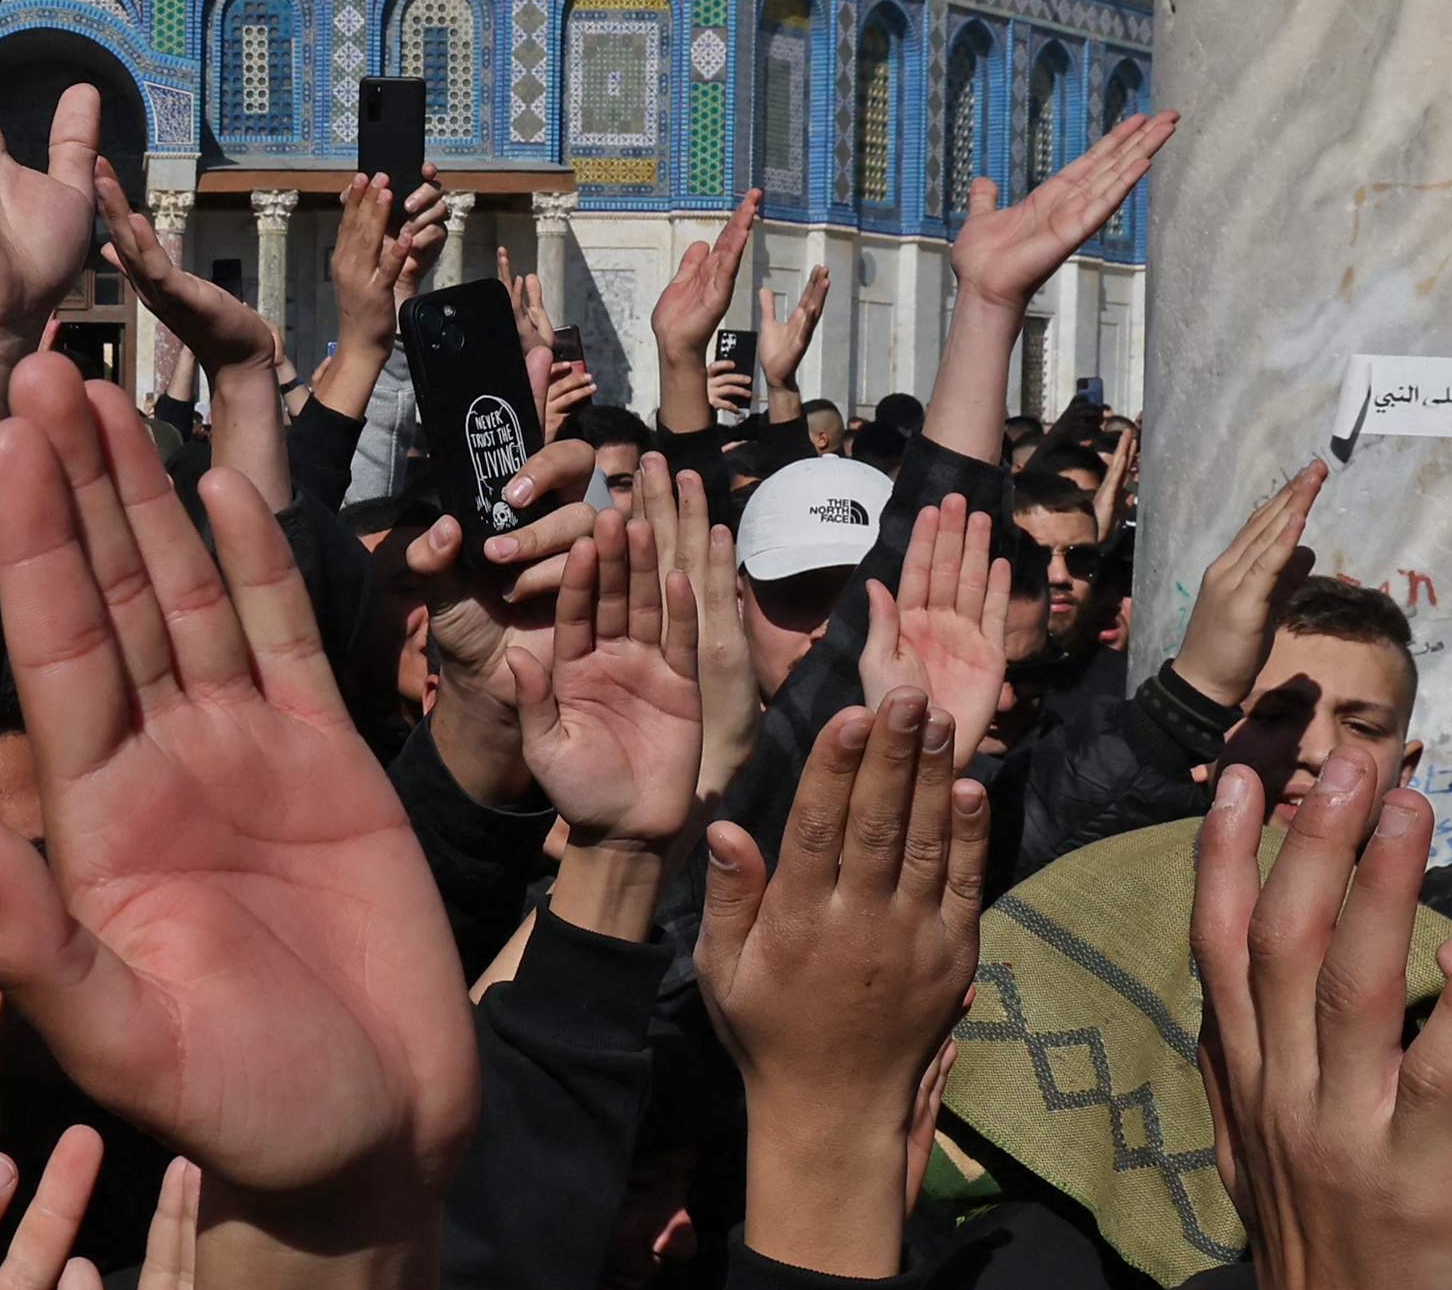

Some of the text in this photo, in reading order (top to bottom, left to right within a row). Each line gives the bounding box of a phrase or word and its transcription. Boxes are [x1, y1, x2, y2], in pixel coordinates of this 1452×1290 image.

[1374, 385, 1419, 414] النبي
[475, 411, 503, 430] NEVER
[470, 423, 514, 448] TRUST THE
[476, 442, 520, 479] LIVING
[809, 506, 849, 515] NORTH
[827, 499, 849, 507] THE
[821, 514, 849, 524] FACE
